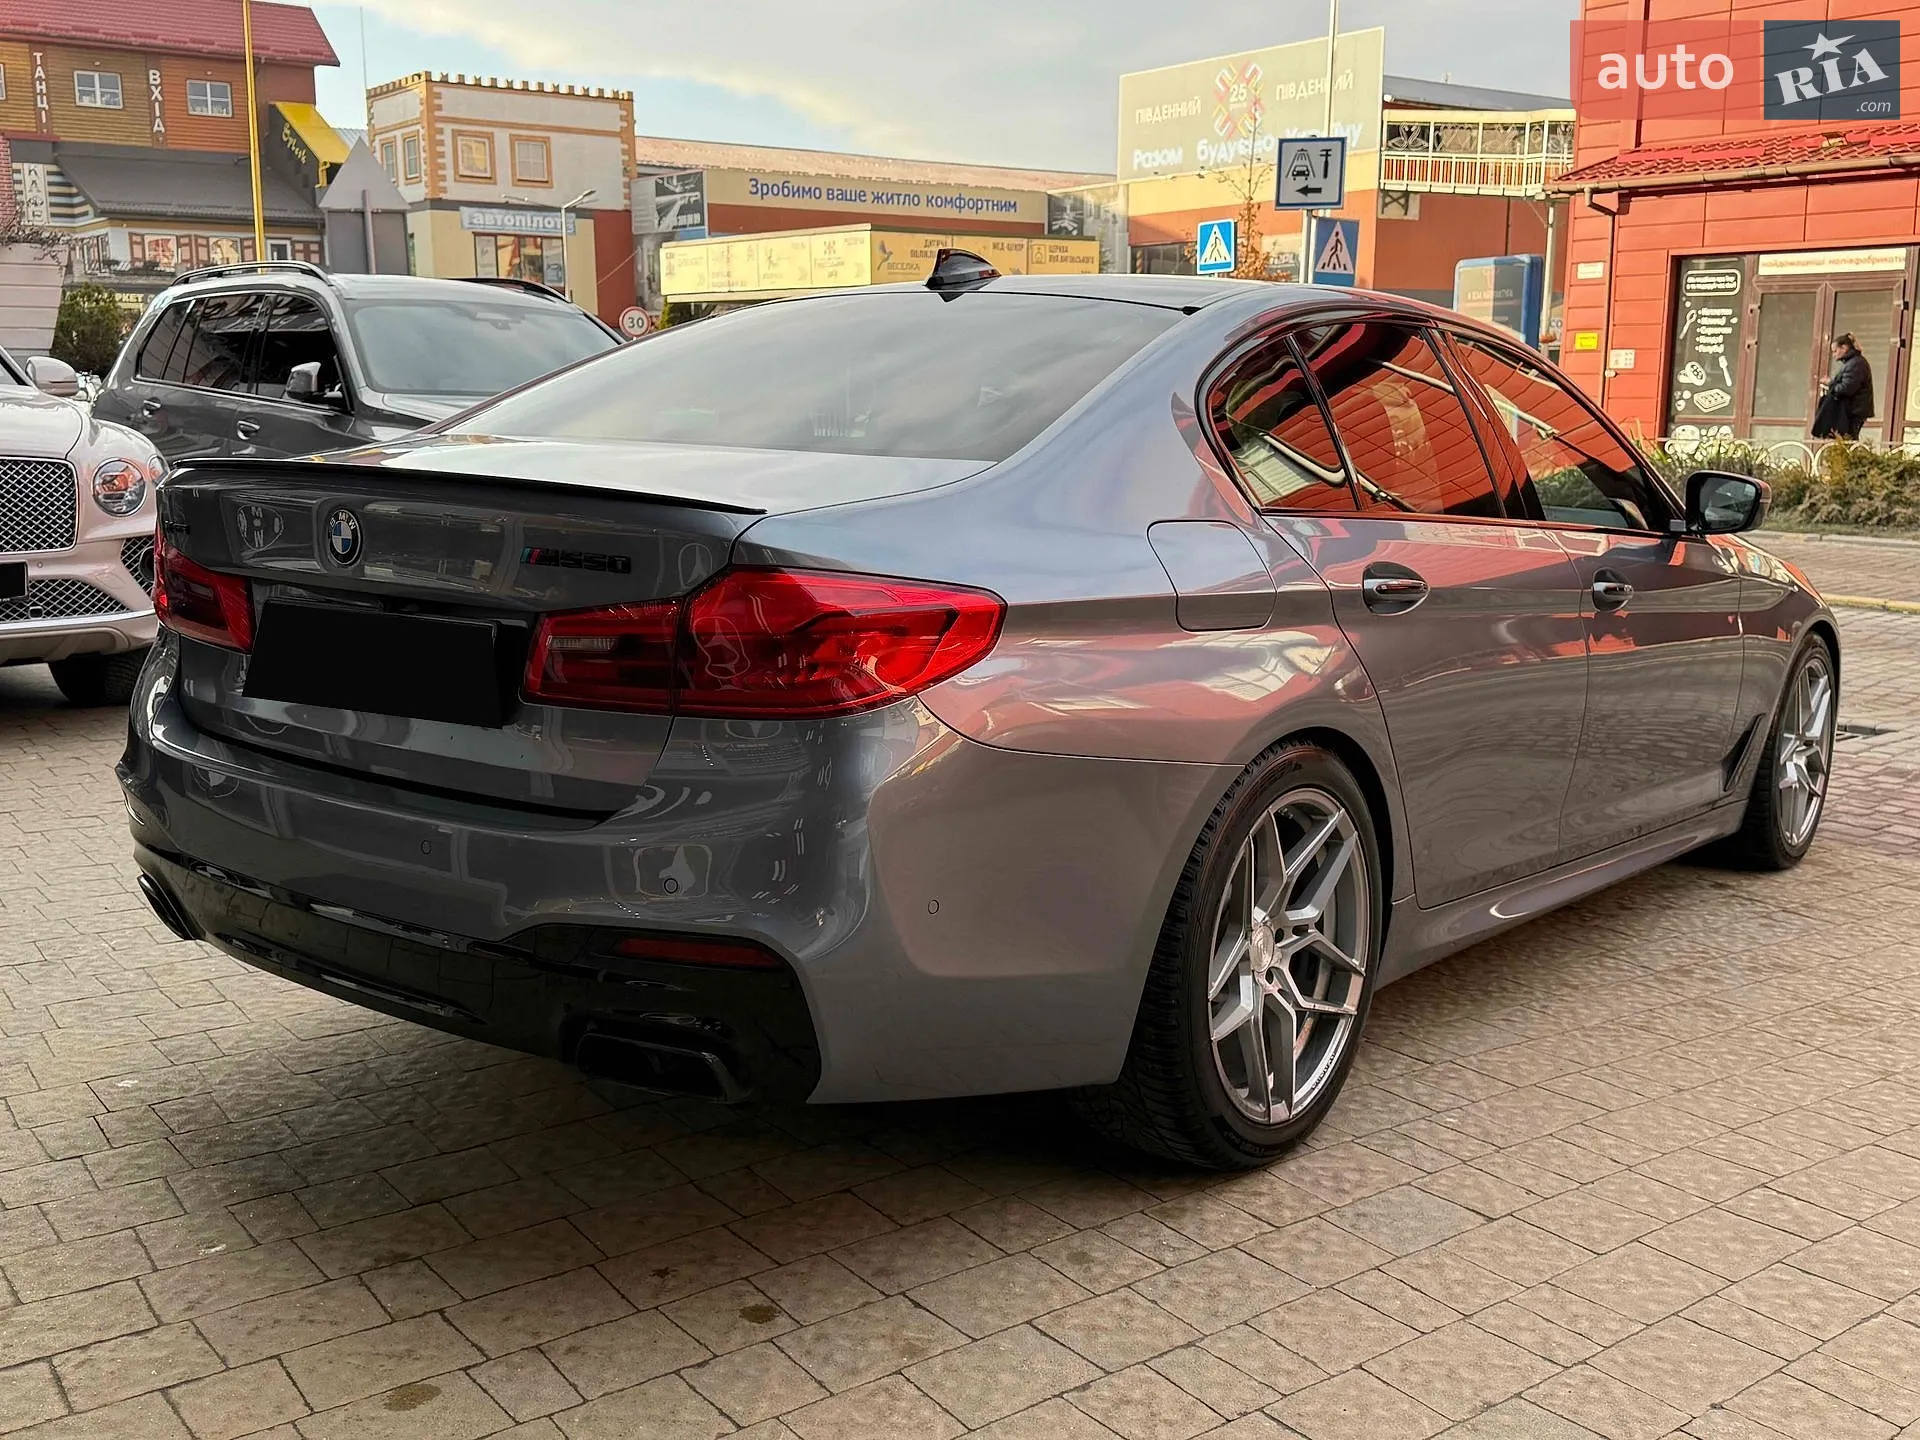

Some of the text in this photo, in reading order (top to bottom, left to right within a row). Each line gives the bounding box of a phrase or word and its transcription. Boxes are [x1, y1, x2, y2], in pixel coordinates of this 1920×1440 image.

[33, 52, 49, 124] ТАНЦІ
[1230, 84, 1248, 102] 25
[1135, 95, 1202, 125] ПІВДЕННИЙ
[1132, 146, 1184, 171] Разом
[749, 177, 1018, 213] Зробимо ваше житло комфортним
[627, 316, 645, 329] 30
